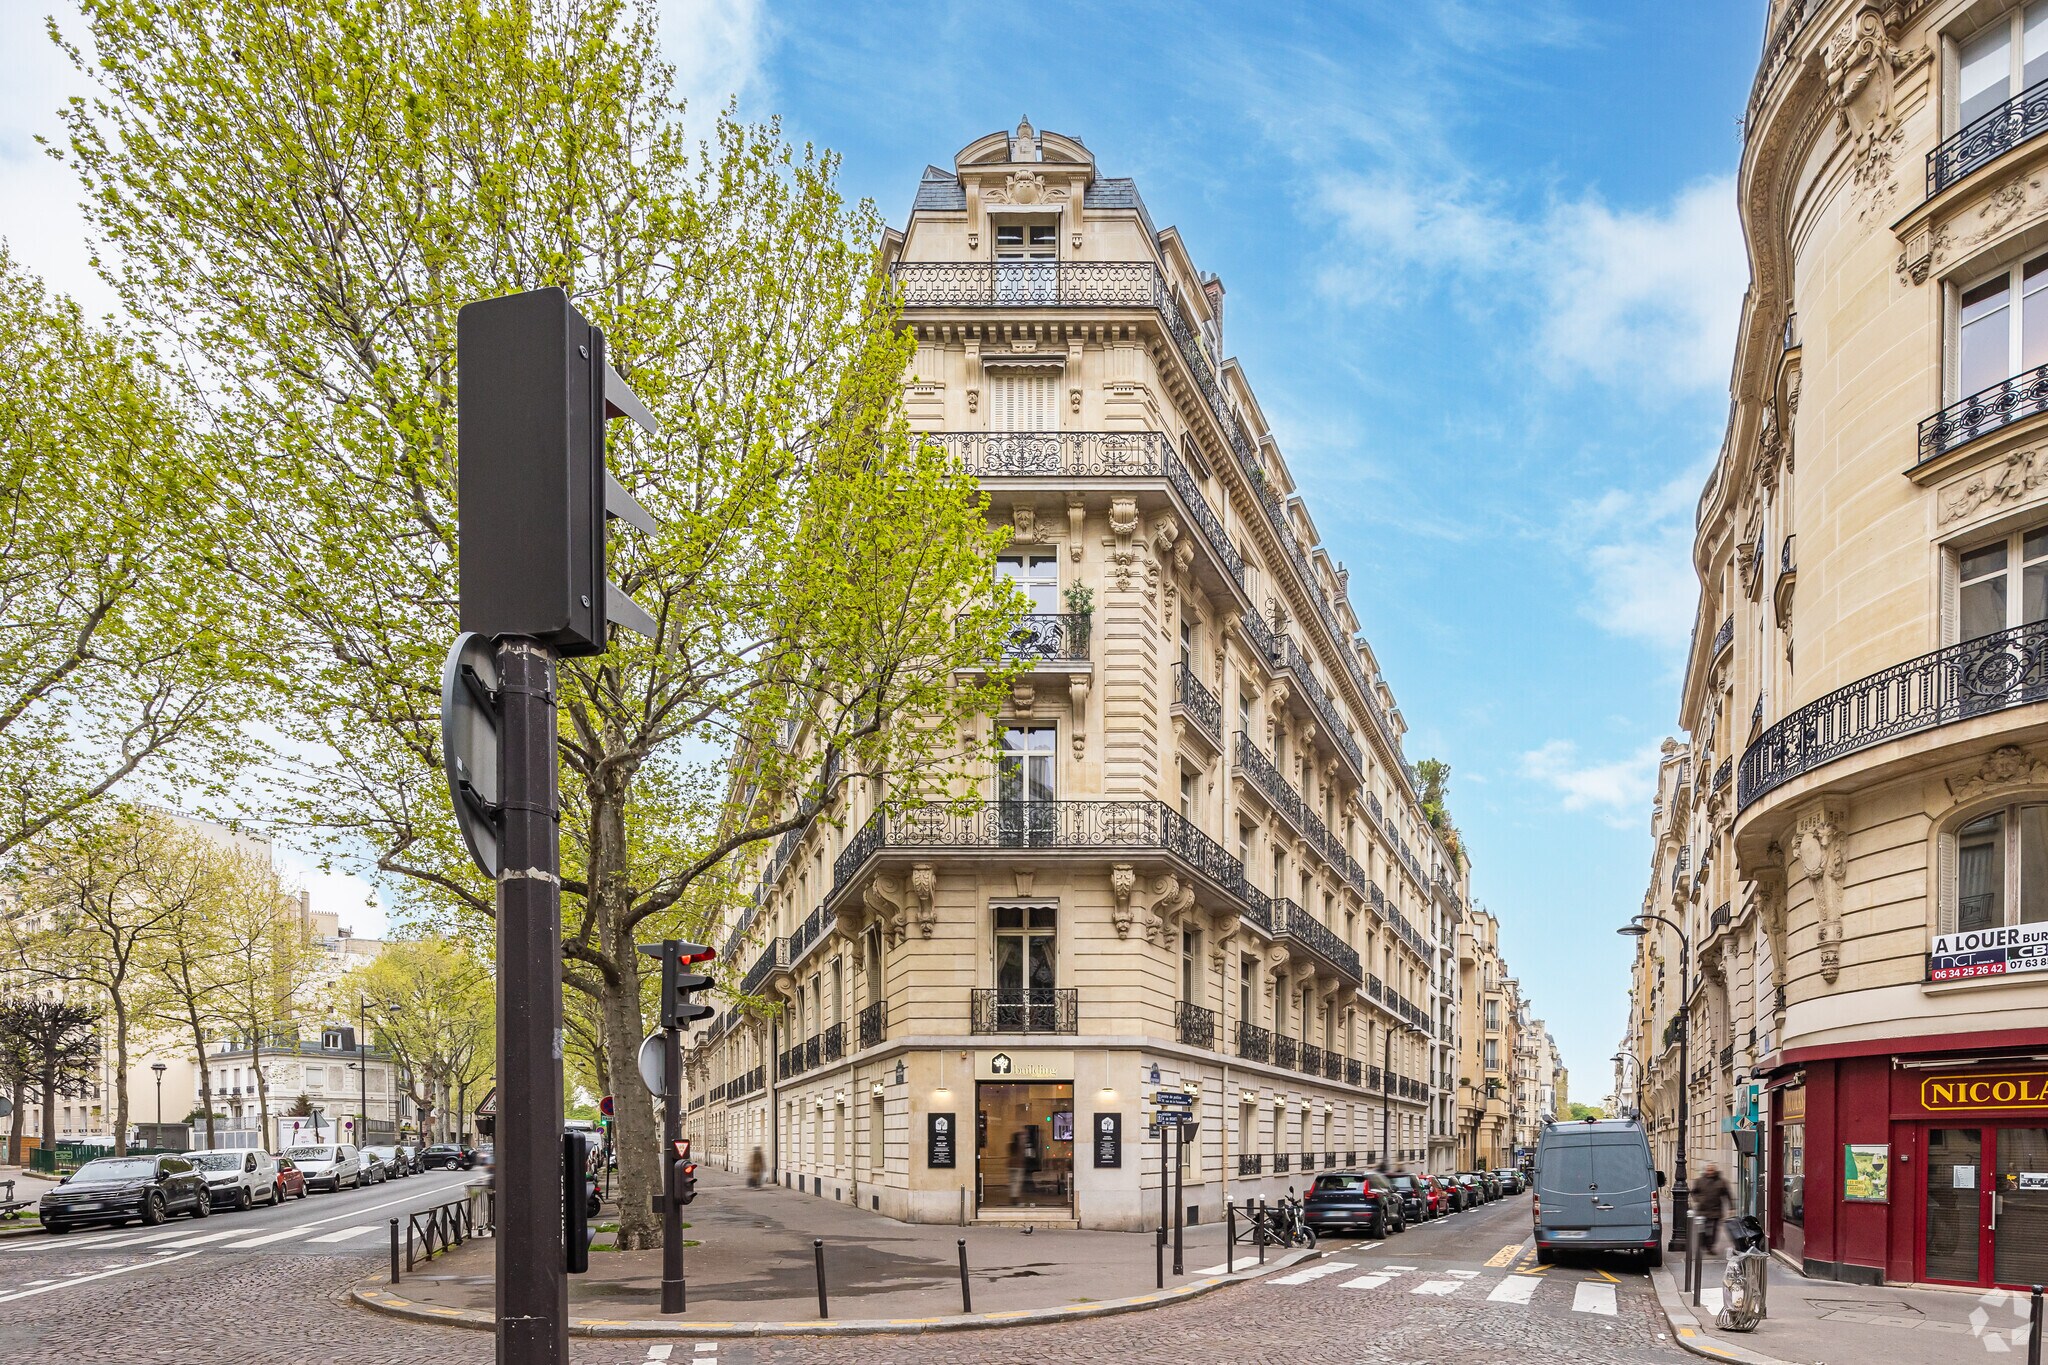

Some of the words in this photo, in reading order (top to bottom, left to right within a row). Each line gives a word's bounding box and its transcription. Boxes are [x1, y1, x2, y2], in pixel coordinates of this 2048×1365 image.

[1935, 939, 1949, 954] A
[1956, 929, 2019, 951] LOUER
[2019, 945, 2048, 957] CB
[2010, 961, 2022, 969] 07
[2025, 959, 2037, 967] 63
[2040, 958, 2048, 966] 8
[1935, 970, 1947, 979] 06
[1949, 968, 1960, 978] 34
[1962, 967, 1974, 976] 25
[1976, 965, 1988, 975] 26
[1991, 964, 2003, 973] 42
[1013, 1065, 1057, 1075] building
